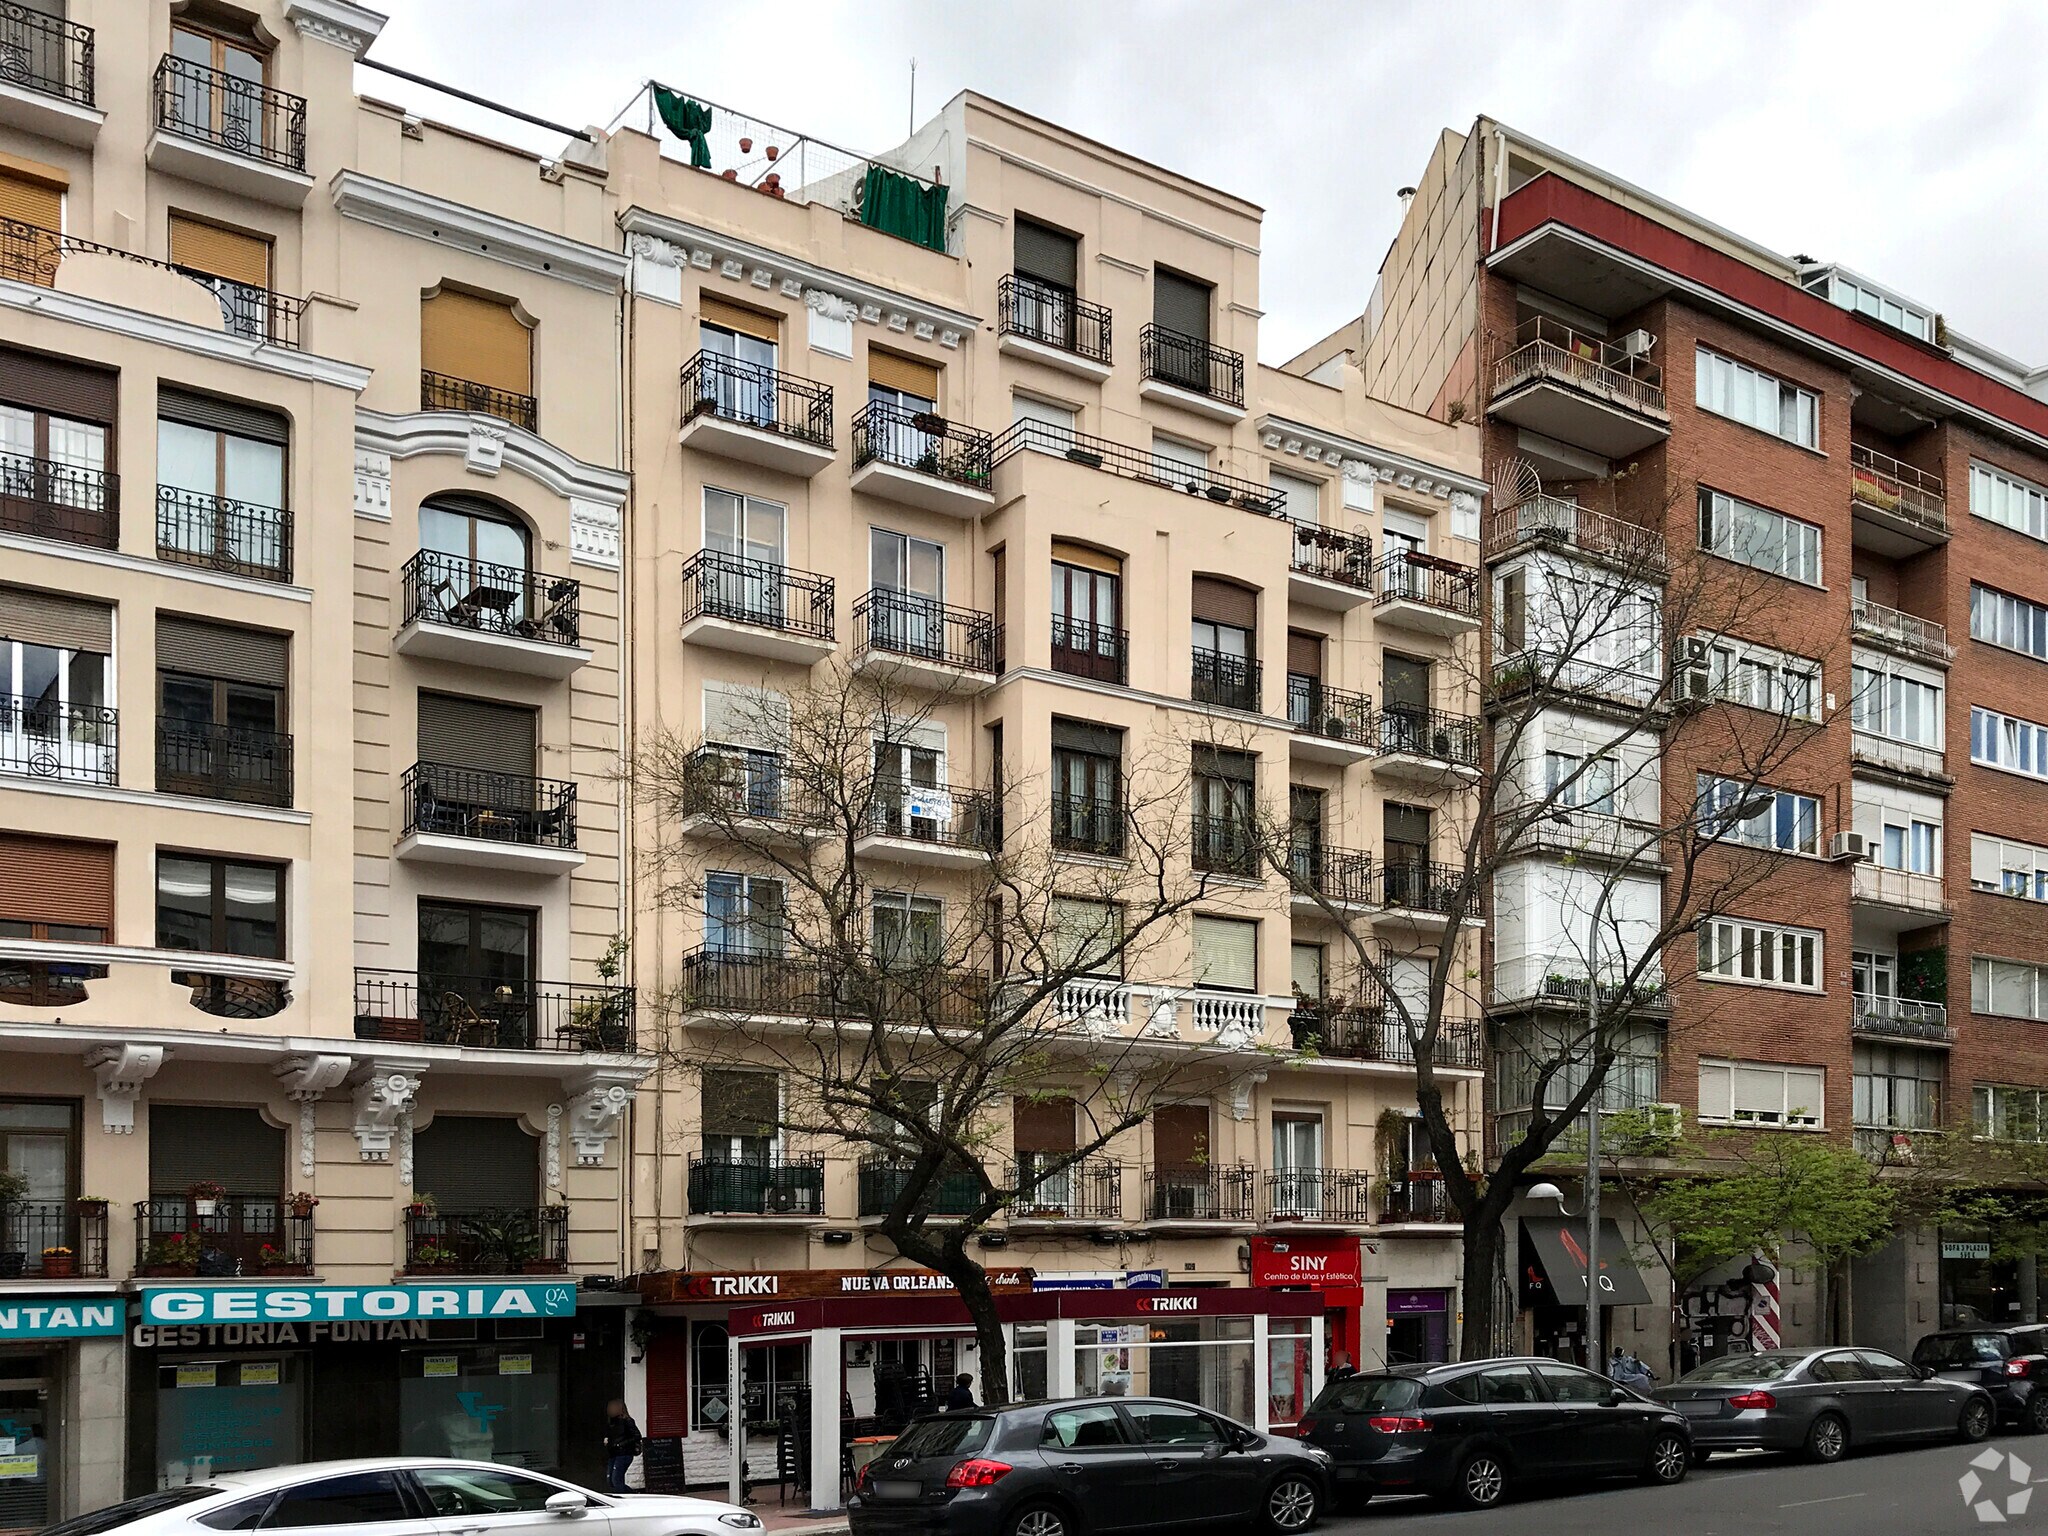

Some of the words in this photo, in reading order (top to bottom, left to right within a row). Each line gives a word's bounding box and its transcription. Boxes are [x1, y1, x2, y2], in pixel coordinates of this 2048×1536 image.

[1290, 1255, 1328, 1271] SINY
[841, 1276, 890, 1291] NUEVA
[893, 1275, 955, 1290] ORLEANS
[995, 1272, 1020, 1285] drinks
[1264, 1272, 1289, 1280] Centro
[1290, 1272, 1300, 1280] de
[1301, 1272, 1319, 1280] Uñas
[711, 1275, 778, 1296] TRIKKI
[151, 1289, 537, 1320] GESTORIA
[1151, 1296, 1198, 1311] TRIKKI
[762, 1311, 795, 1327] TRIKKI
[133, 1321, 299, 1347] GESTORIA
[309, 1320, 428, 1343] FONTAN
